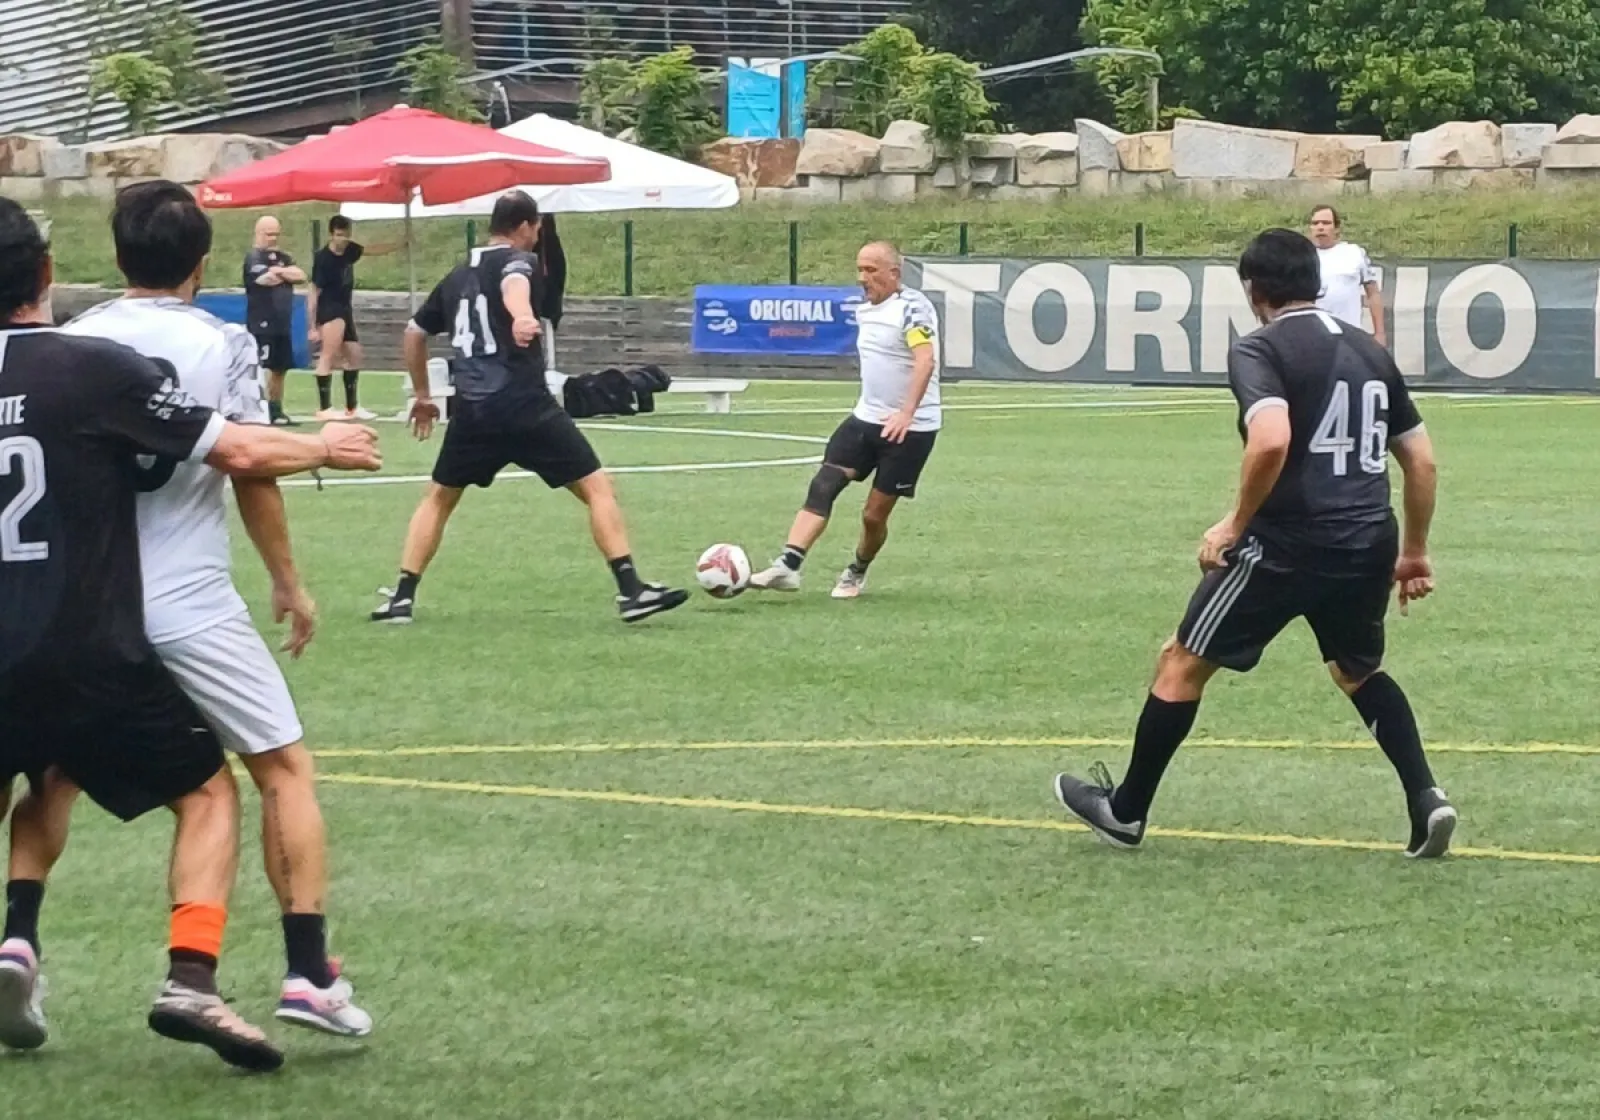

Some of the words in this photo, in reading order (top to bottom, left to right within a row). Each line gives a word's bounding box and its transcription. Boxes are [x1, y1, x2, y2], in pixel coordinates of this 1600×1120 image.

[452, 294, 497, 358] 41
[750, 299, 834, 322] ORIGINAL
[1309, 380, 1389, 476] 46
